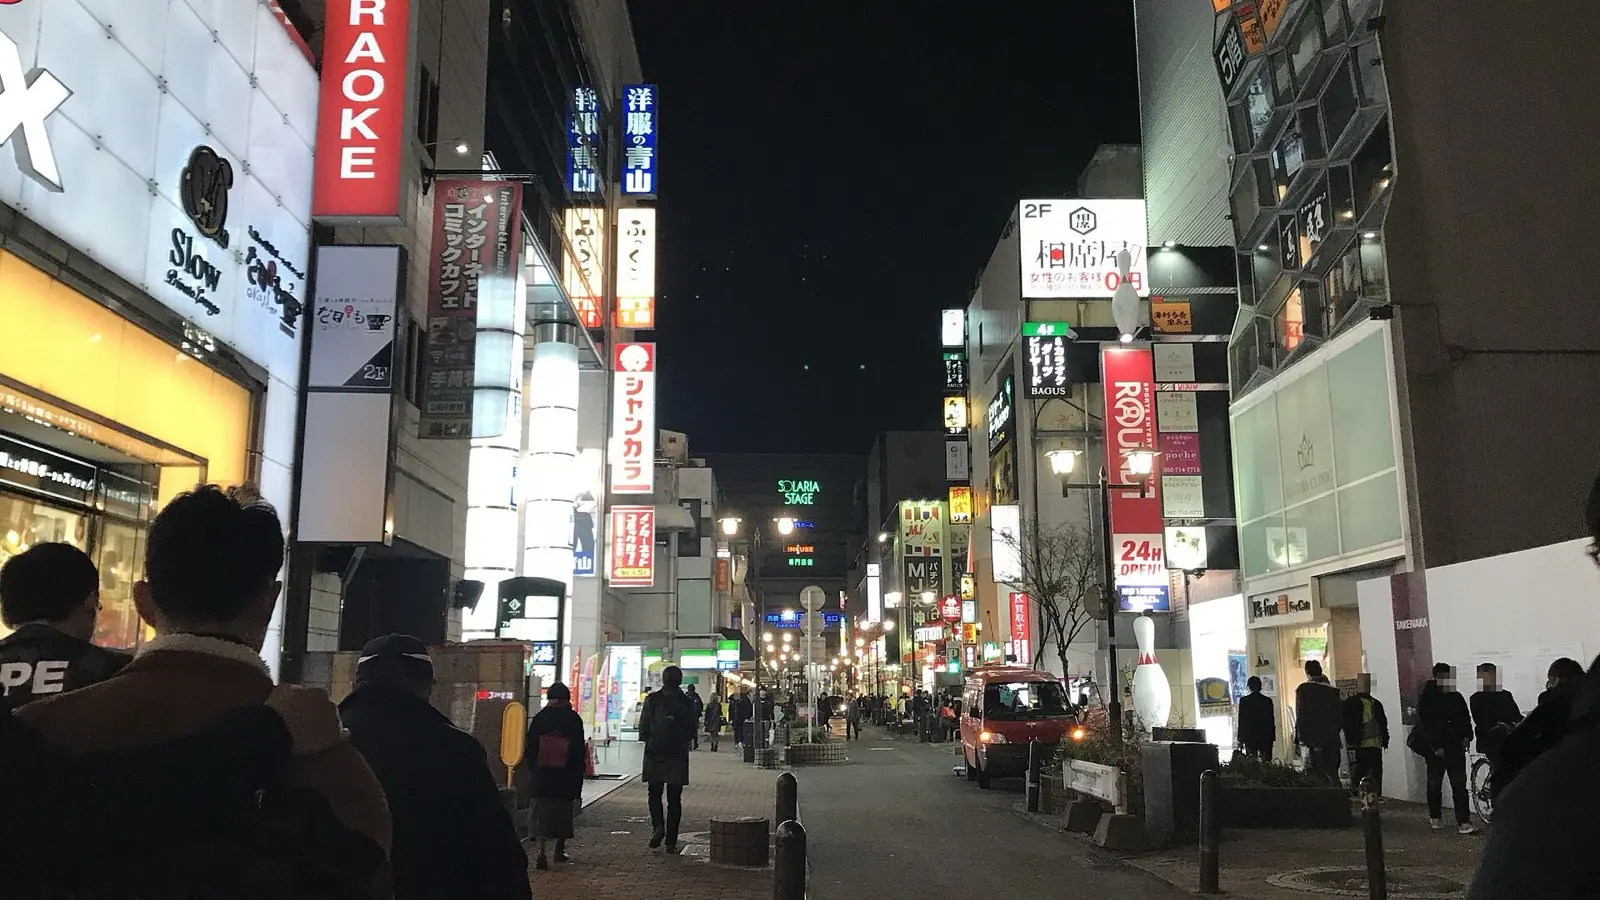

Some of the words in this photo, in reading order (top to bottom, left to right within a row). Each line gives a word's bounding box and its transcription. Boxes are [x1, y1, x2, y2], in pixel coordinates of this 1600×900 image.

[626, 88, 653, 193] 洋服の青山
[1025, 204, 1052, 218] 2F
[168, 228, 222, 292] Slow
[440, 204, 464, 308] コミックカフェ
[463, 203, 488, 308] インターネット
[1031, 272, 1102, 284] 女性のお客様
[1037, 324, 1054, 335] 4F
[1029, 337, 1042, 386] ビリヤード
[1041, 343, 1053, 377] ダーツ
[363, 364, 387, 380] 2F
[1031, 387, 1066, 395] BAGUS
[1165, 451, 1197, 461] poche
[778, 480, 820, 492] SOLARIA
[784, 493, 813, 504] STAGE
[1121, 540, 1162, 561] 24H
[1120, 563, 1161, 576] OPEN!
[1395, 618, 1428, 630] TAKENAKA
